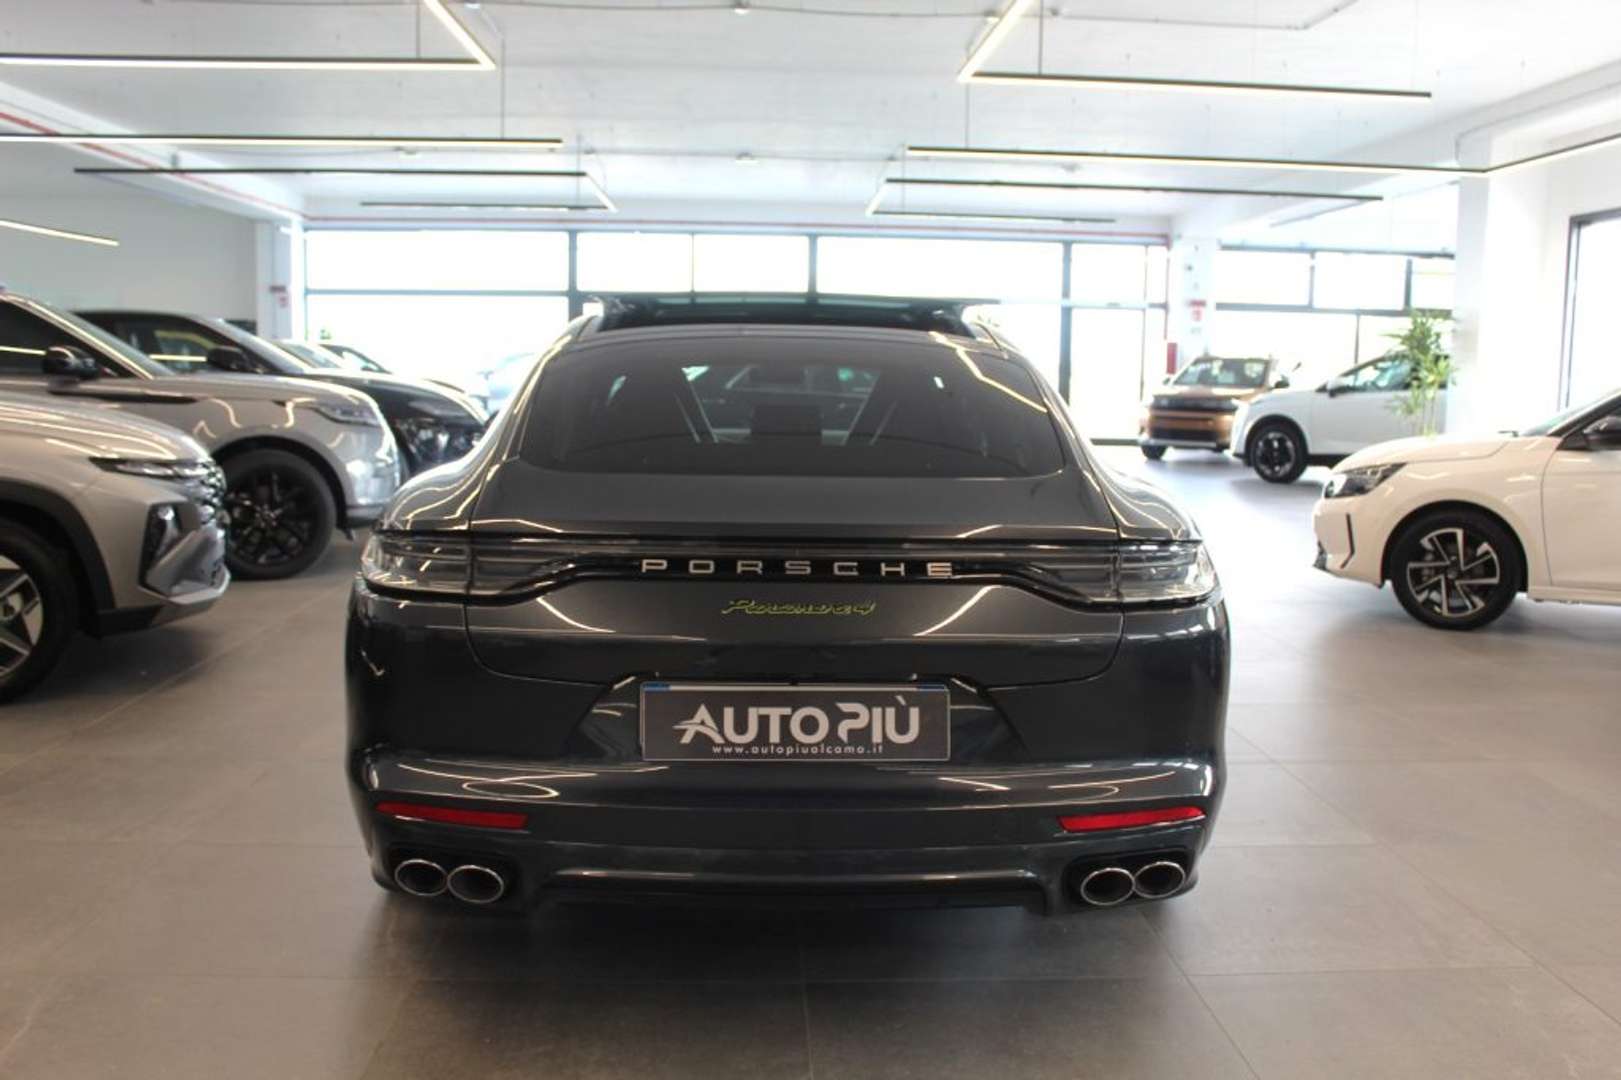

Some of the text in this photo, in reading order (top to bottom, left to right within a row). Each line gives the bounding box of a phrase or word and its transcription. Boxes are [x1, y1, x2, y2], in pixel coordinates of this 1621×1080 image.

[641, 558, 953, 577] PORSCHE
[673, 703, 830, 745] AUTO
[712, 744, 883, 756] www.autopiualcamo.it
